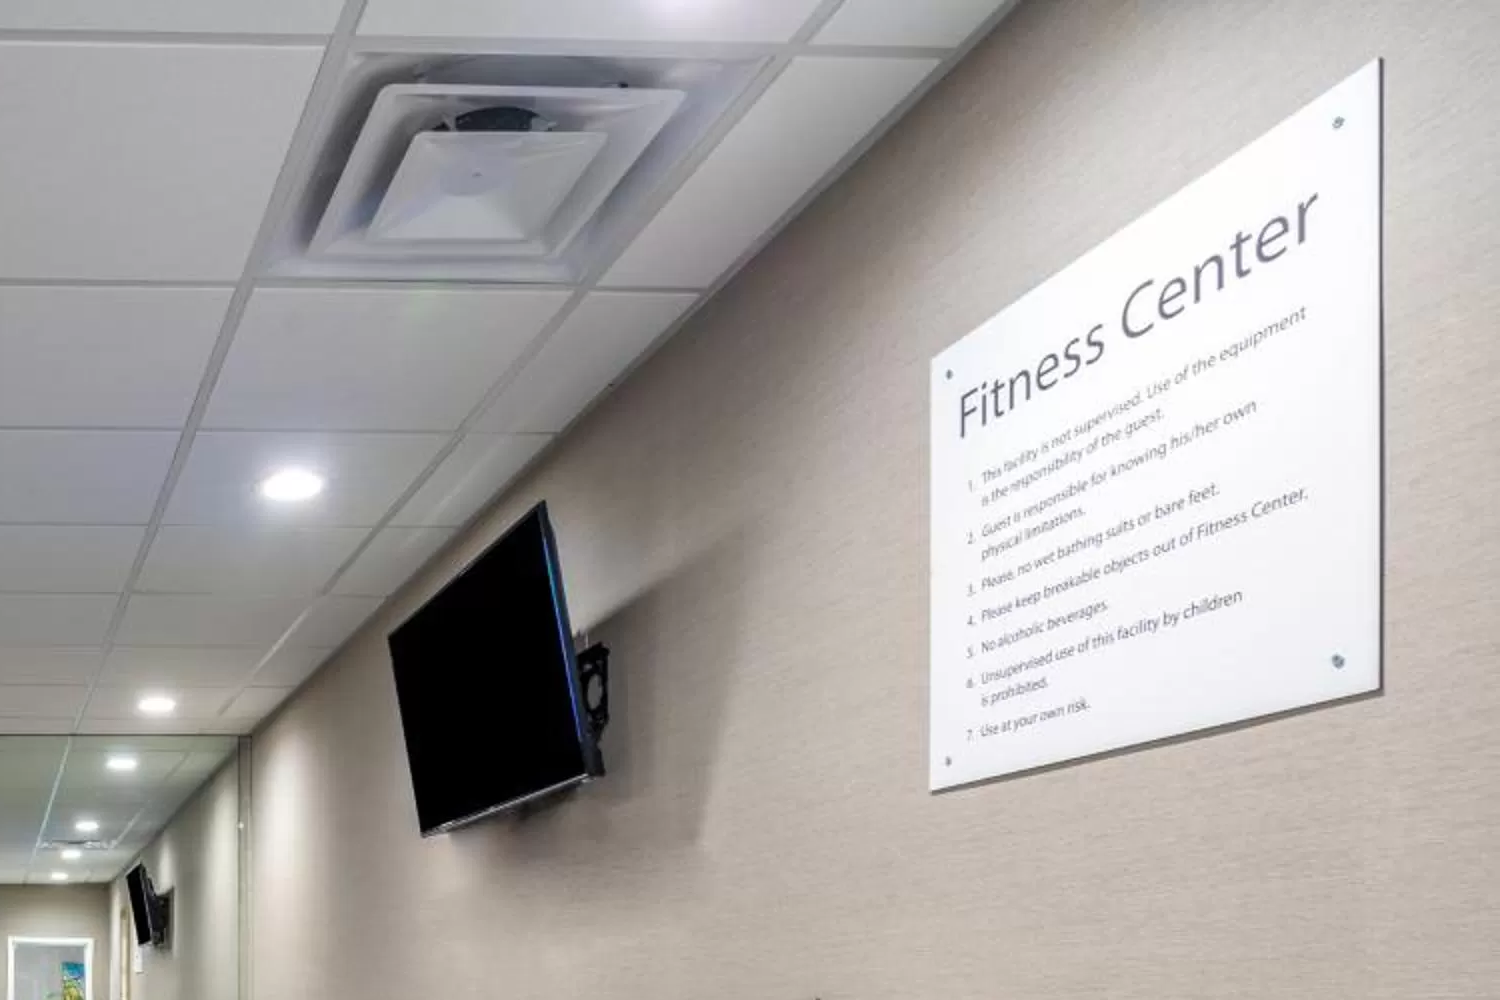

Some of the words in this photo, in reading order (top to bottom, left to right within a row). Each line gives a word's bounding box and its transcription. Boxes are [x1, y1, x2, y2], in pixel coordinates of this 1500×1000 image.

[959, 322, 1105, 439] Fitness
[1120, 192, 1319, 340] Center
[982, 467, 1002, 485] This
[1003, 447, 1039, 472] facility
[1041, 438, 1049, 454] is
[1051, 428, 1072, 449] not
[1074, 390, 1144, 438] supervised.
[1146, 378, 1171, 400] Use
[1174, 363, 1189, 385] of
[1191, 355, 1217, 377] the
[1219, 305, 1307, 361] equipment
[981, 515, 1012, 538] Guest
[1023, 479, 1089, 519] responsible
[1090, 469, 1108, 488] for
[1110, 442, 1168, 478] knowing
[1169, 416, 1222, 450] his/her
[1222, 400, 1257, 426] own
[991, 484, 1009, 502] the
[1010, 446, 1084, 492] responsibility
[1086, 436, 1100, 456] of
[1101, 427, 1122, 448] the
[1124, 407, 1165, 439] guest.
[981, 531, 1023, 563] physical
[1024, 506, 1087, 541] limitations.
[981, 601, 1013, 623] Please
[1014, 589, 1042, 609] keep
[1043, 567, 1101, 599] breakable
[1102, 547, 1150, 576] objects
[1152, 536, 1177, 557] out
[1179, 526, 1195, 548] of
[1196, 511, 1249, 541] Fitness
[1250, 487, 1309, 519] Center.
[1017, 562, 1033, 577] no
[1033, 551, 1057, 570] wet
[1057, 532, 1104, 560] bathing
[1105, 516, 1136, 541] suits
[1137, 510, 1152, 527] or
[1154, 496, 1186, 520] bare
[1188, 481, 1221, 506] feet.
[981, 639, 998, 655] No
[998, 622, 1045, 649] alcoholic
[1046, 599, 1109, 631] beverages.
[981, 649, 1054, 685] Unsupervised
[1054, 645, 1076, 662] use
[1077, 635, 1091, 654] of
[1091, 631, 1115, 651] this
[1116, 615, 1161, 642] facility
[1162, 611, 1181, 628] by
[1182, 590, 1244, 620] children
[980, 722, 1000, 738] Use
[1000, 718, 1012, 733] at
[1013, 712, 1039, 733] your
[1039, 705, 1065, 723] own
[1066, 696, 1092, 715] risk.
[981, 693, 989, 708] is
[990, 676, 1049, 707] prohibited.
